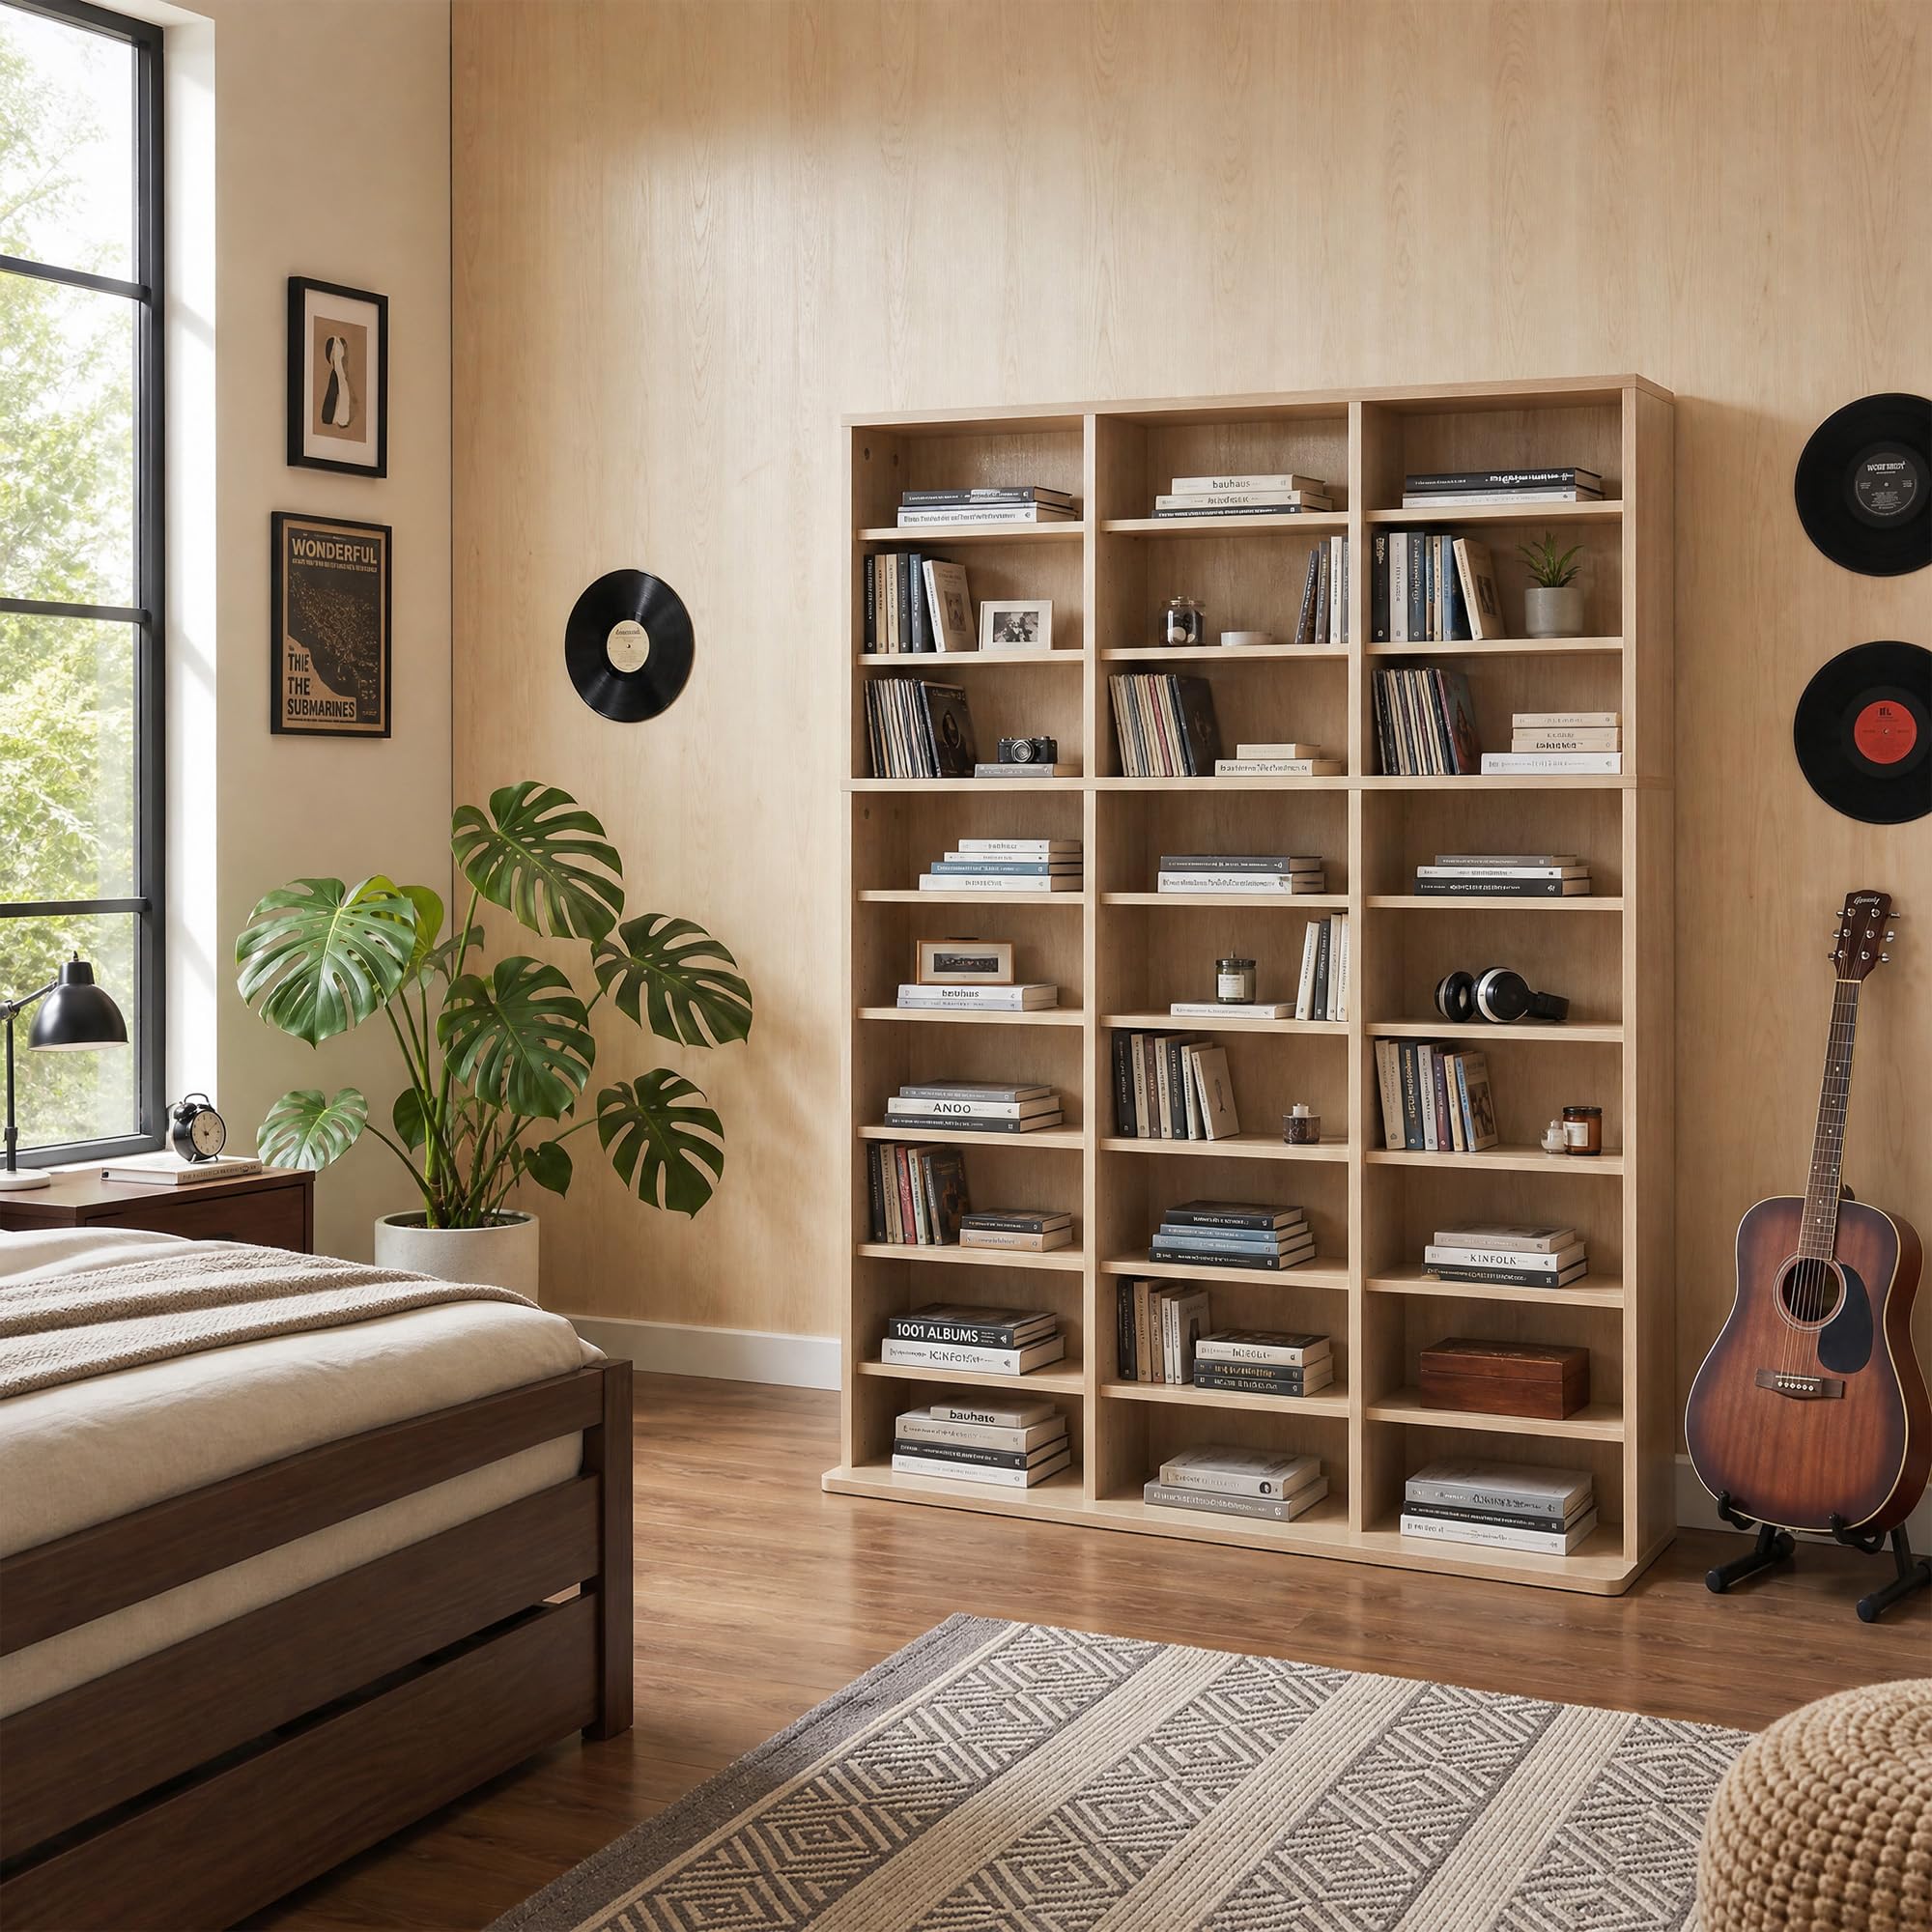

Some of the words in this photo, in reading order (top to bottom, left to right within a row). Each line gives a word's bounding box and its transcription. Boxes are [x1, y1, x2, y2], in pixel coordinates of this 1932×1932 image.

[1212, 479, 1251, 489] bauhaus
[292, 537, 378, 564] WONDERFUL
[288, 677, 310, 696] THE
[287, 697, 355, 718] SUBMARINES
[895, 1322, 924, 1338] 1001
[927, 1326, 979, 1343] ALBUMS
